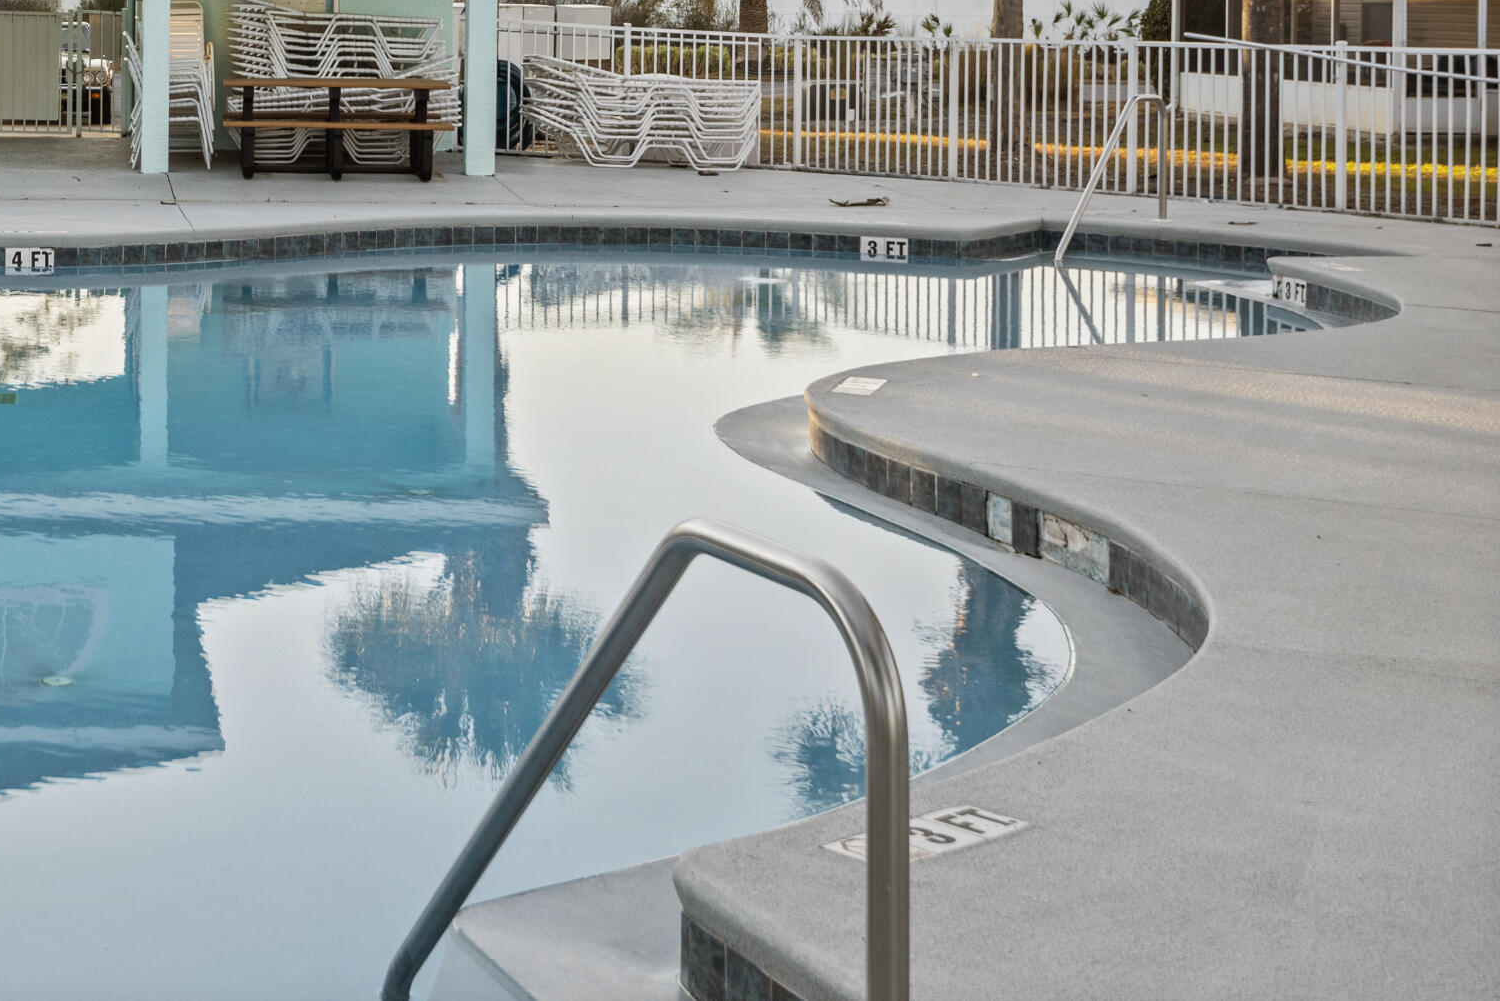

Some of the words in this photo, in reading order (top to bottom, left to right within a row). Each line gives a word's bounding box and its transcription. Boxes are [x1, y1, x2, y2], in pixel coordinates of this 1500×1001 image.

[867, 240, 878, 258] 3
[11, 251, 23, 272] 4
[1285, 282, 1291, 300] 3
[909, 826, 956, 844] 3
